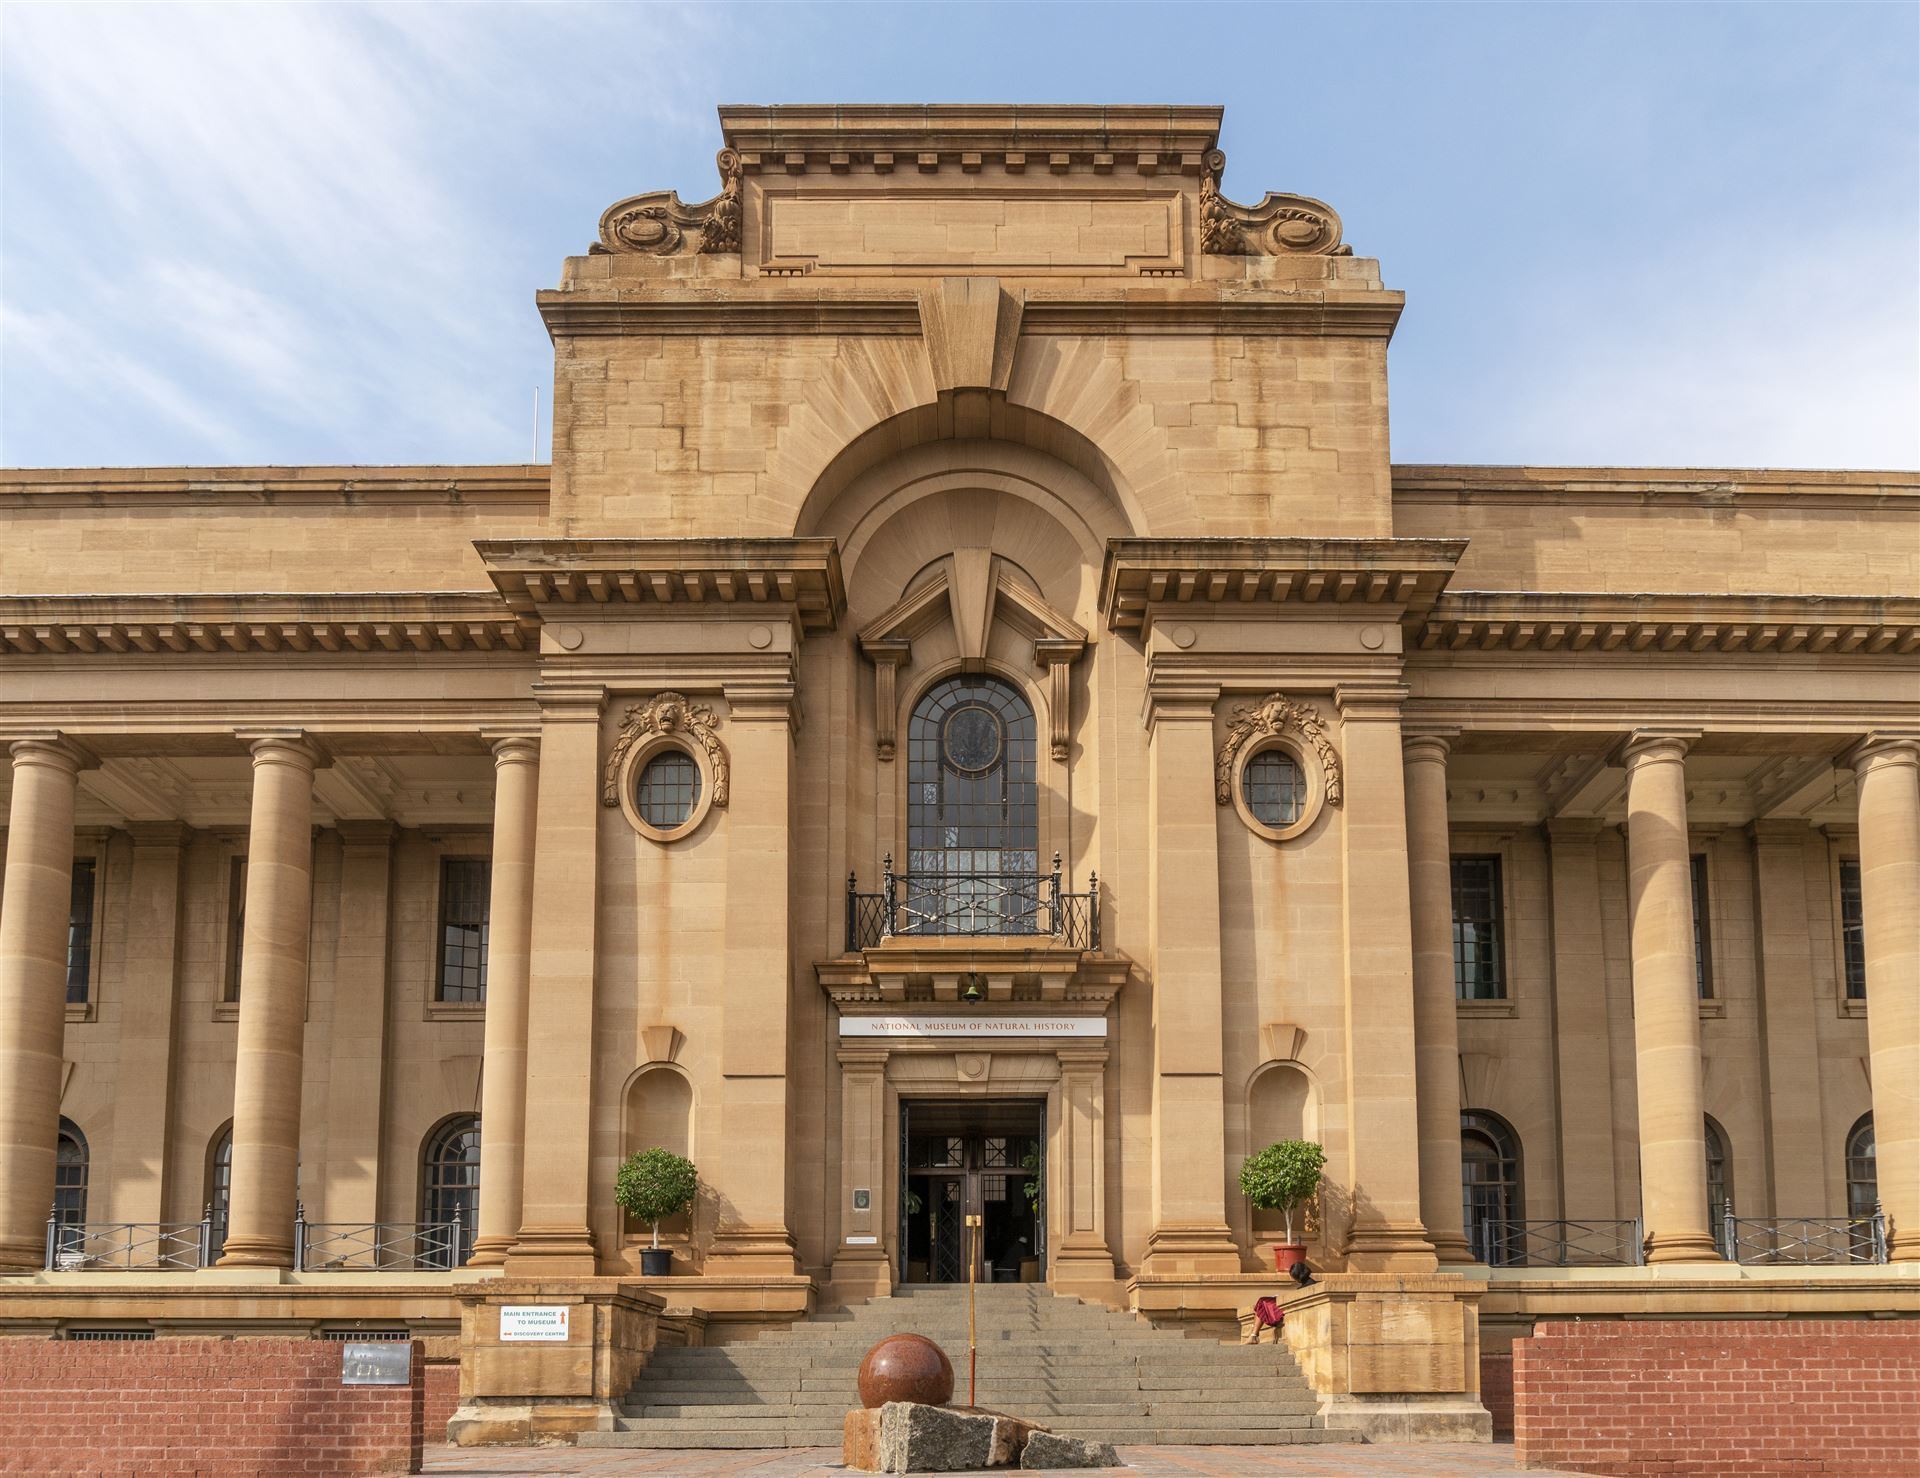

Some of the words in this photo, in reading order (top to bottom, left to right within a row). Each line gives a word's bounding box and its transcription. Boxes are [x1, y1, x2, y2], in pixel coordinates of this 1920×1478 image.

[871, 1022, 922, 1031] NATIONAL
[924, 1022, 966, 1031] MUSEUM
[969, 1022, 983, 1031] OF
[985, 1022, 1031, 1031] NATURAL
[1034, 1022, 1076, 1031] HISTORY
